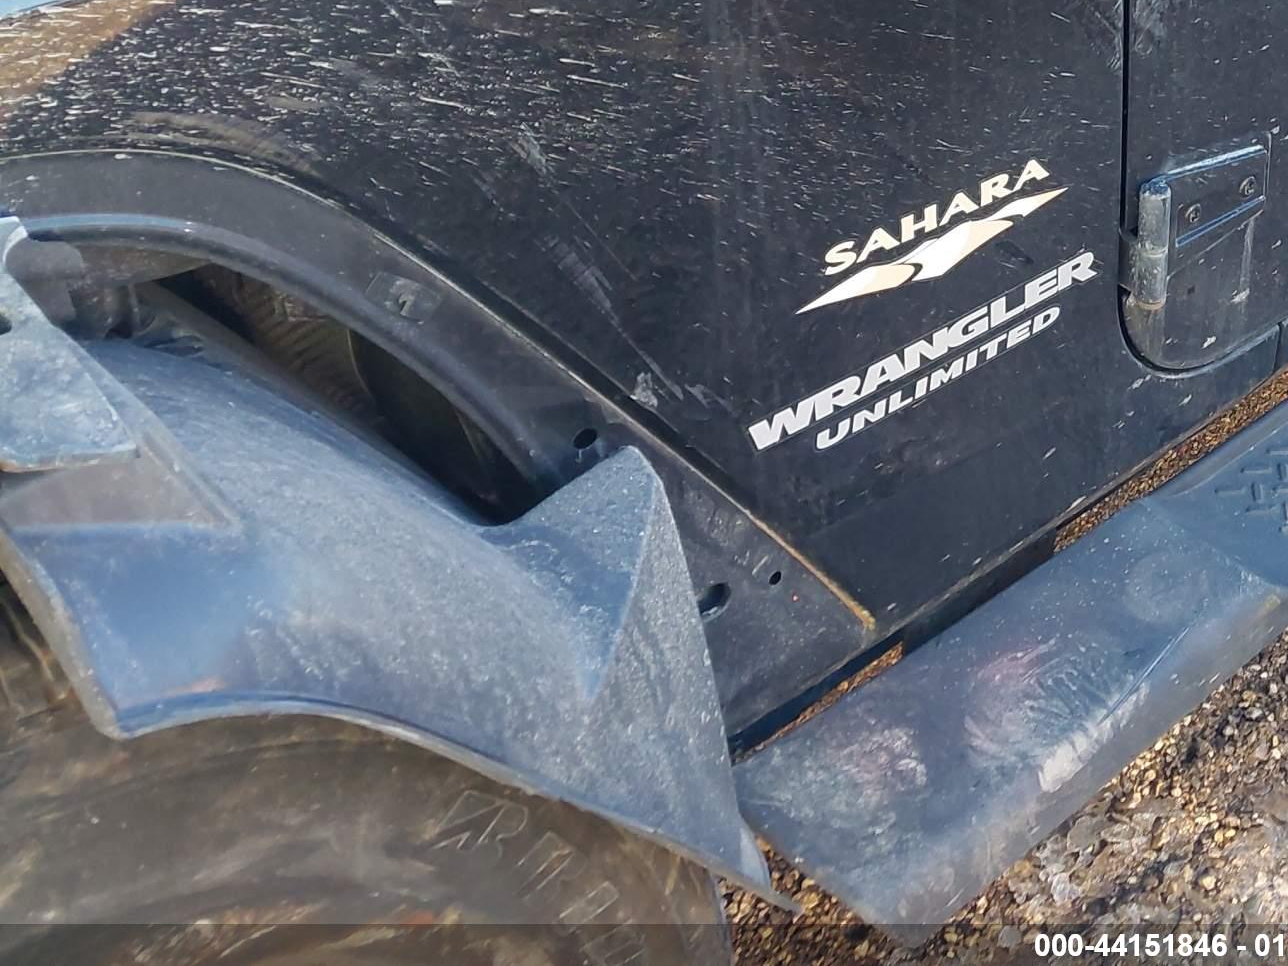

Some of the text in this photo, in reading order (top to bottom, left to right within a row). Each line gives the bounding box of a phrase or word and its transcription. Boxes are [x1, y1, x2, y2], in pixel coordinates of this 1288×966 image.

[823, 158, 1050, 276] SAHARA
[747, 251, 1100, 452] WRANGLER
[814, 306, 1061, 451] UNLIMITED
